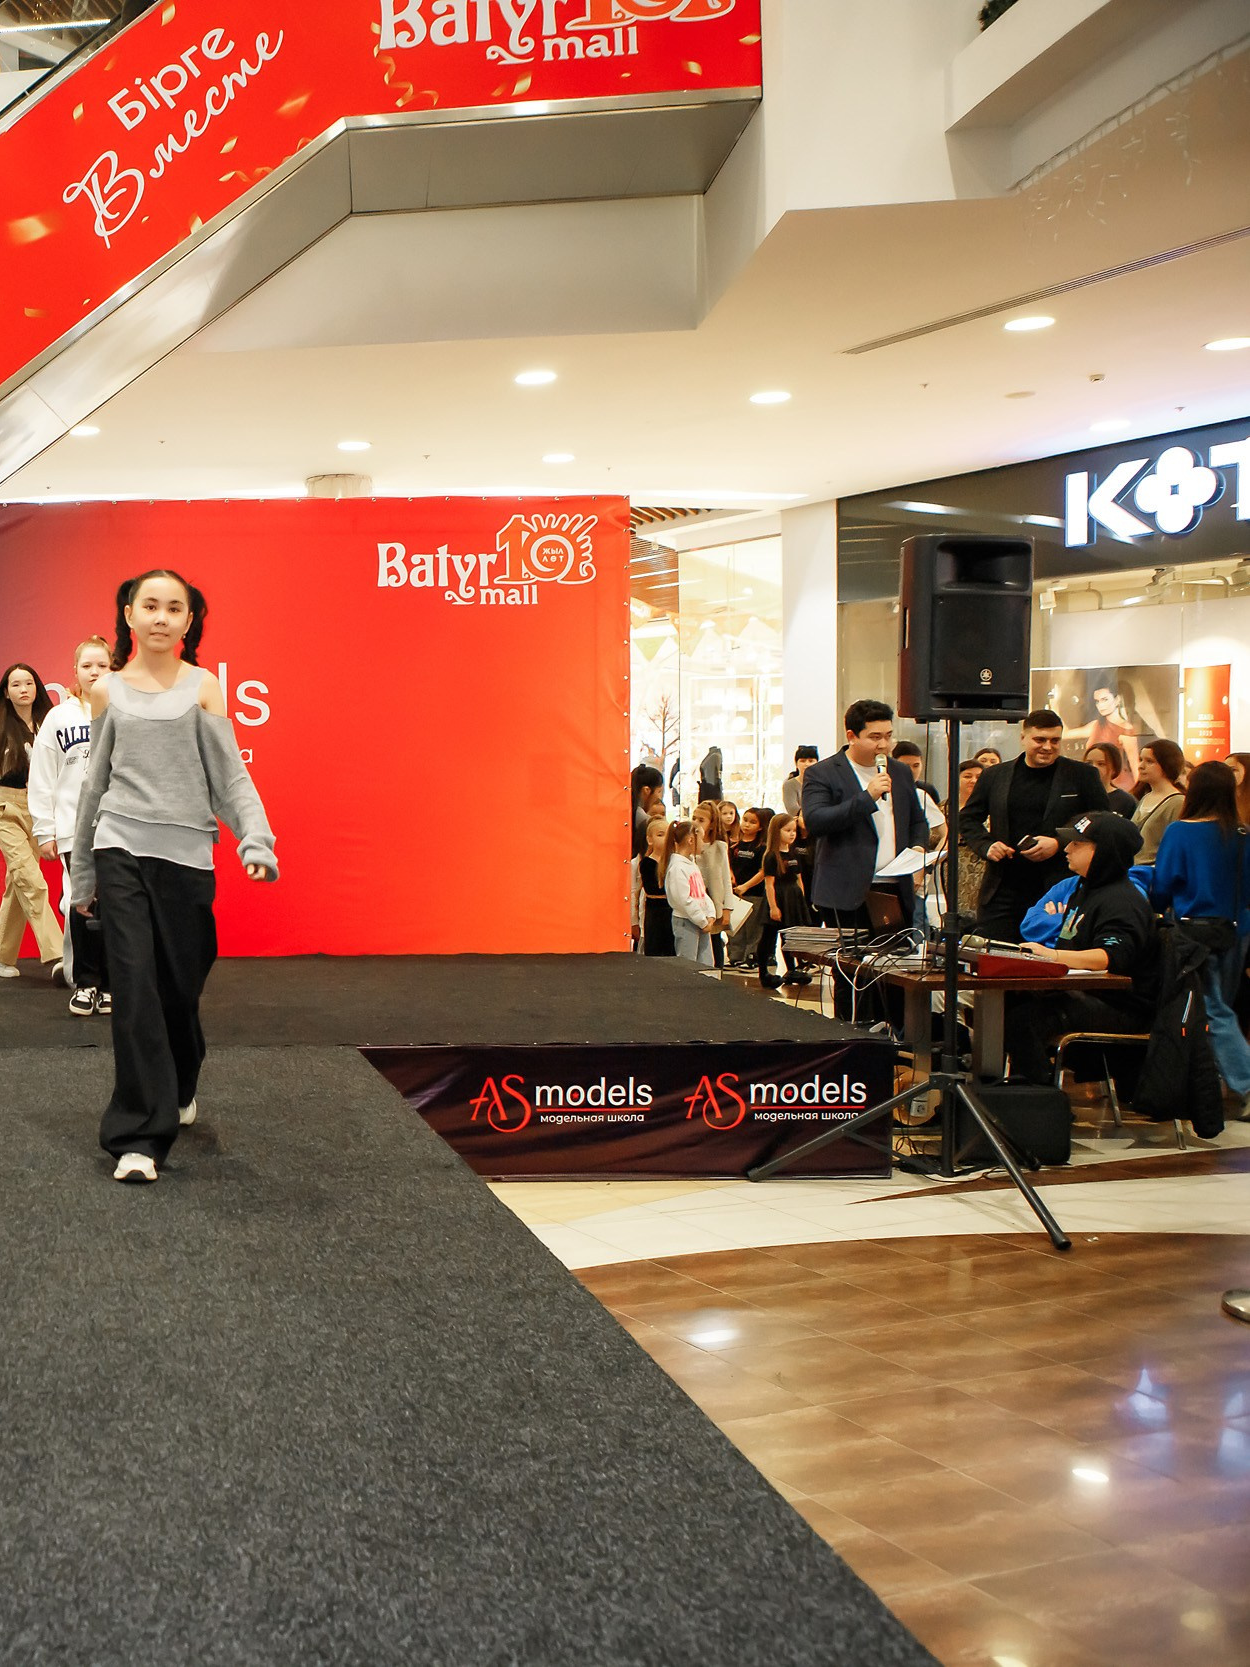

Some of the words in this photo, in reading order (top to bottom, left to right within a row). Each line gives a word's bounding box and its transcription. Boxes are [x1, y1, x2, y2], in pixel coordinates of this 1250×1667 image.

[542, 26, 639, 62] mall
[107, 28, 235, 131] Бірге
[377, 542, 498, 605] Batyr
[480, 584, 539, 605] mall
[469, 1074, 532, 1133] AS
[535, 1076, 653, 1106] models
[540, 1114, 604, 1125] модельная
[607, 1113, 645, 1123] школа
[683, 1072, 746, 1130] AS
[750, 1074, 867, 1104] models
[754, 1112, 818, 1123] модельная
